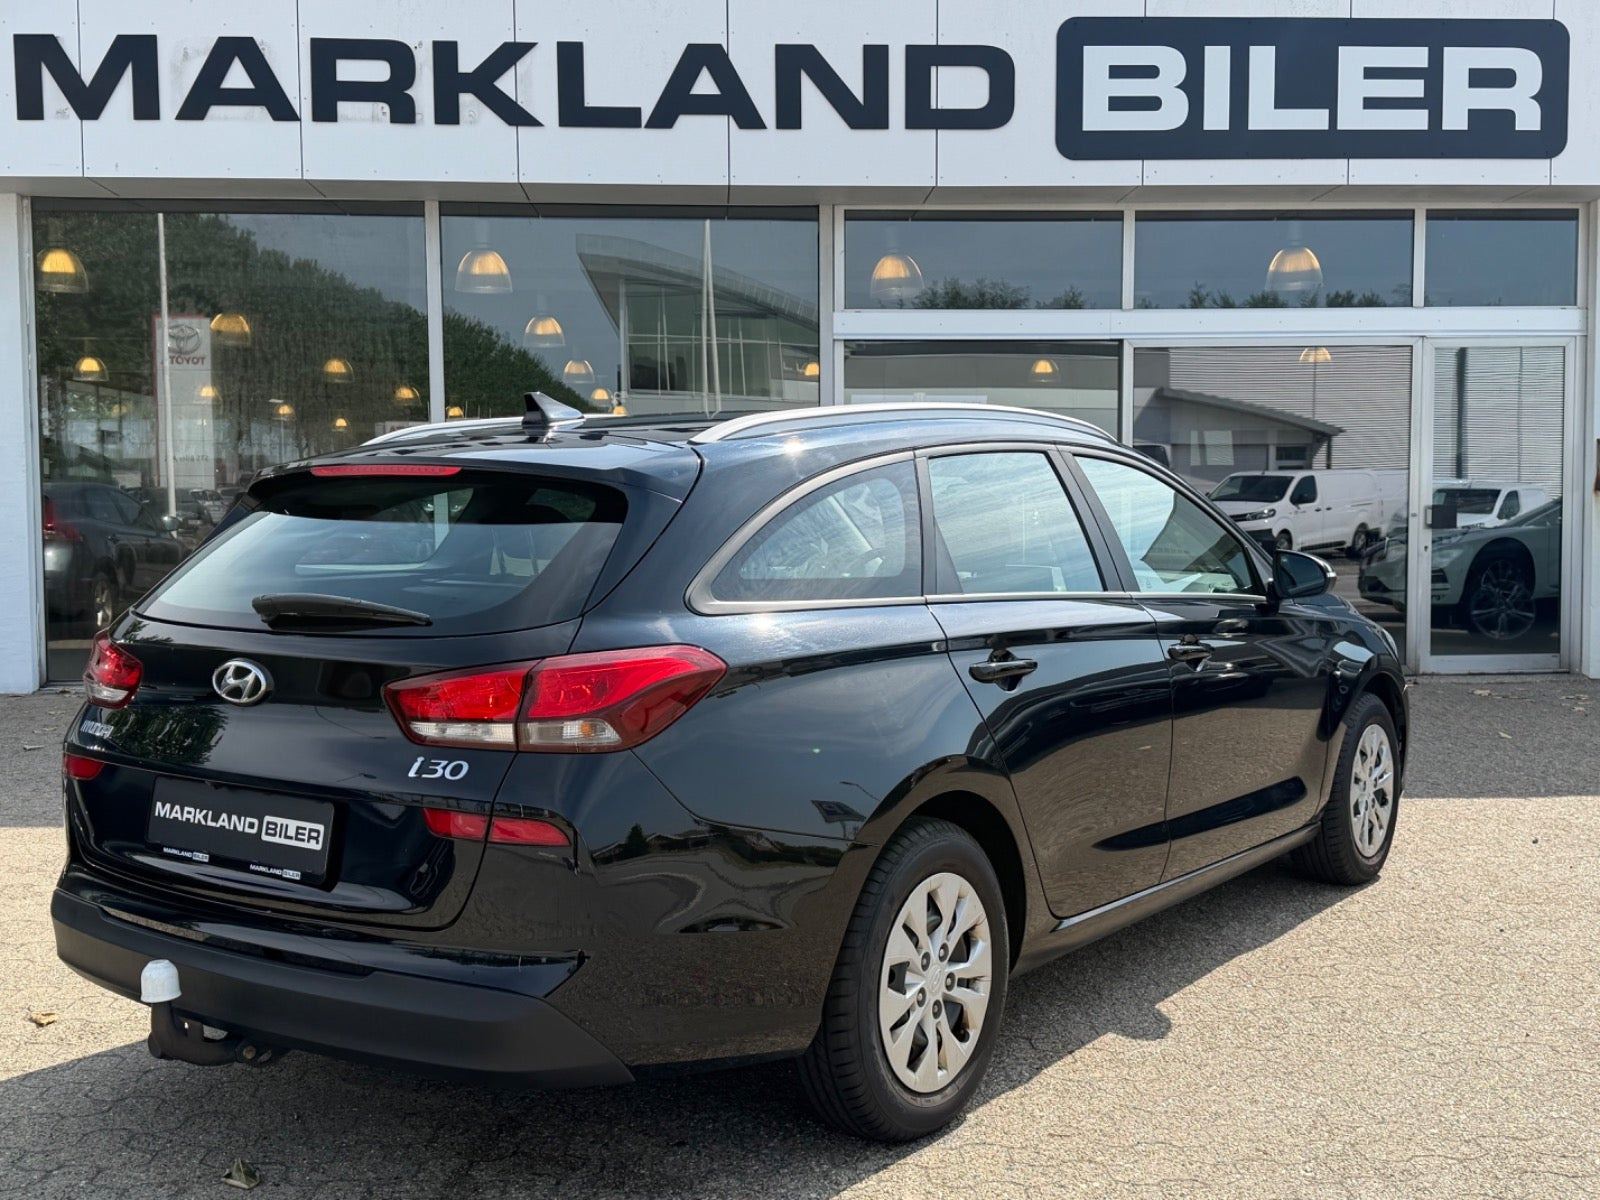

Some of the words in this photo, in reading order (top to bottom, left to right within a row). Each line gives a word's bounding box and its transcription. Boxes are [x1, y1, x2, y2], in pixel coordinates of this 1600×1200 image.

[14, 34, 1016, 132] MARKLAND
[1083, 46, 1542, 132] BILER
[408, 756, 469, 780] i30
[154, 801, 260, 835] MARKLAND
[263, 820, 322, 846] BILER
[163, 847, 193, 858] MARKLAND
[193, 852, 209, 862] BILER
[249, 863, 283, 875] MARKLAND
[282, 869, 301, 880] BILER
